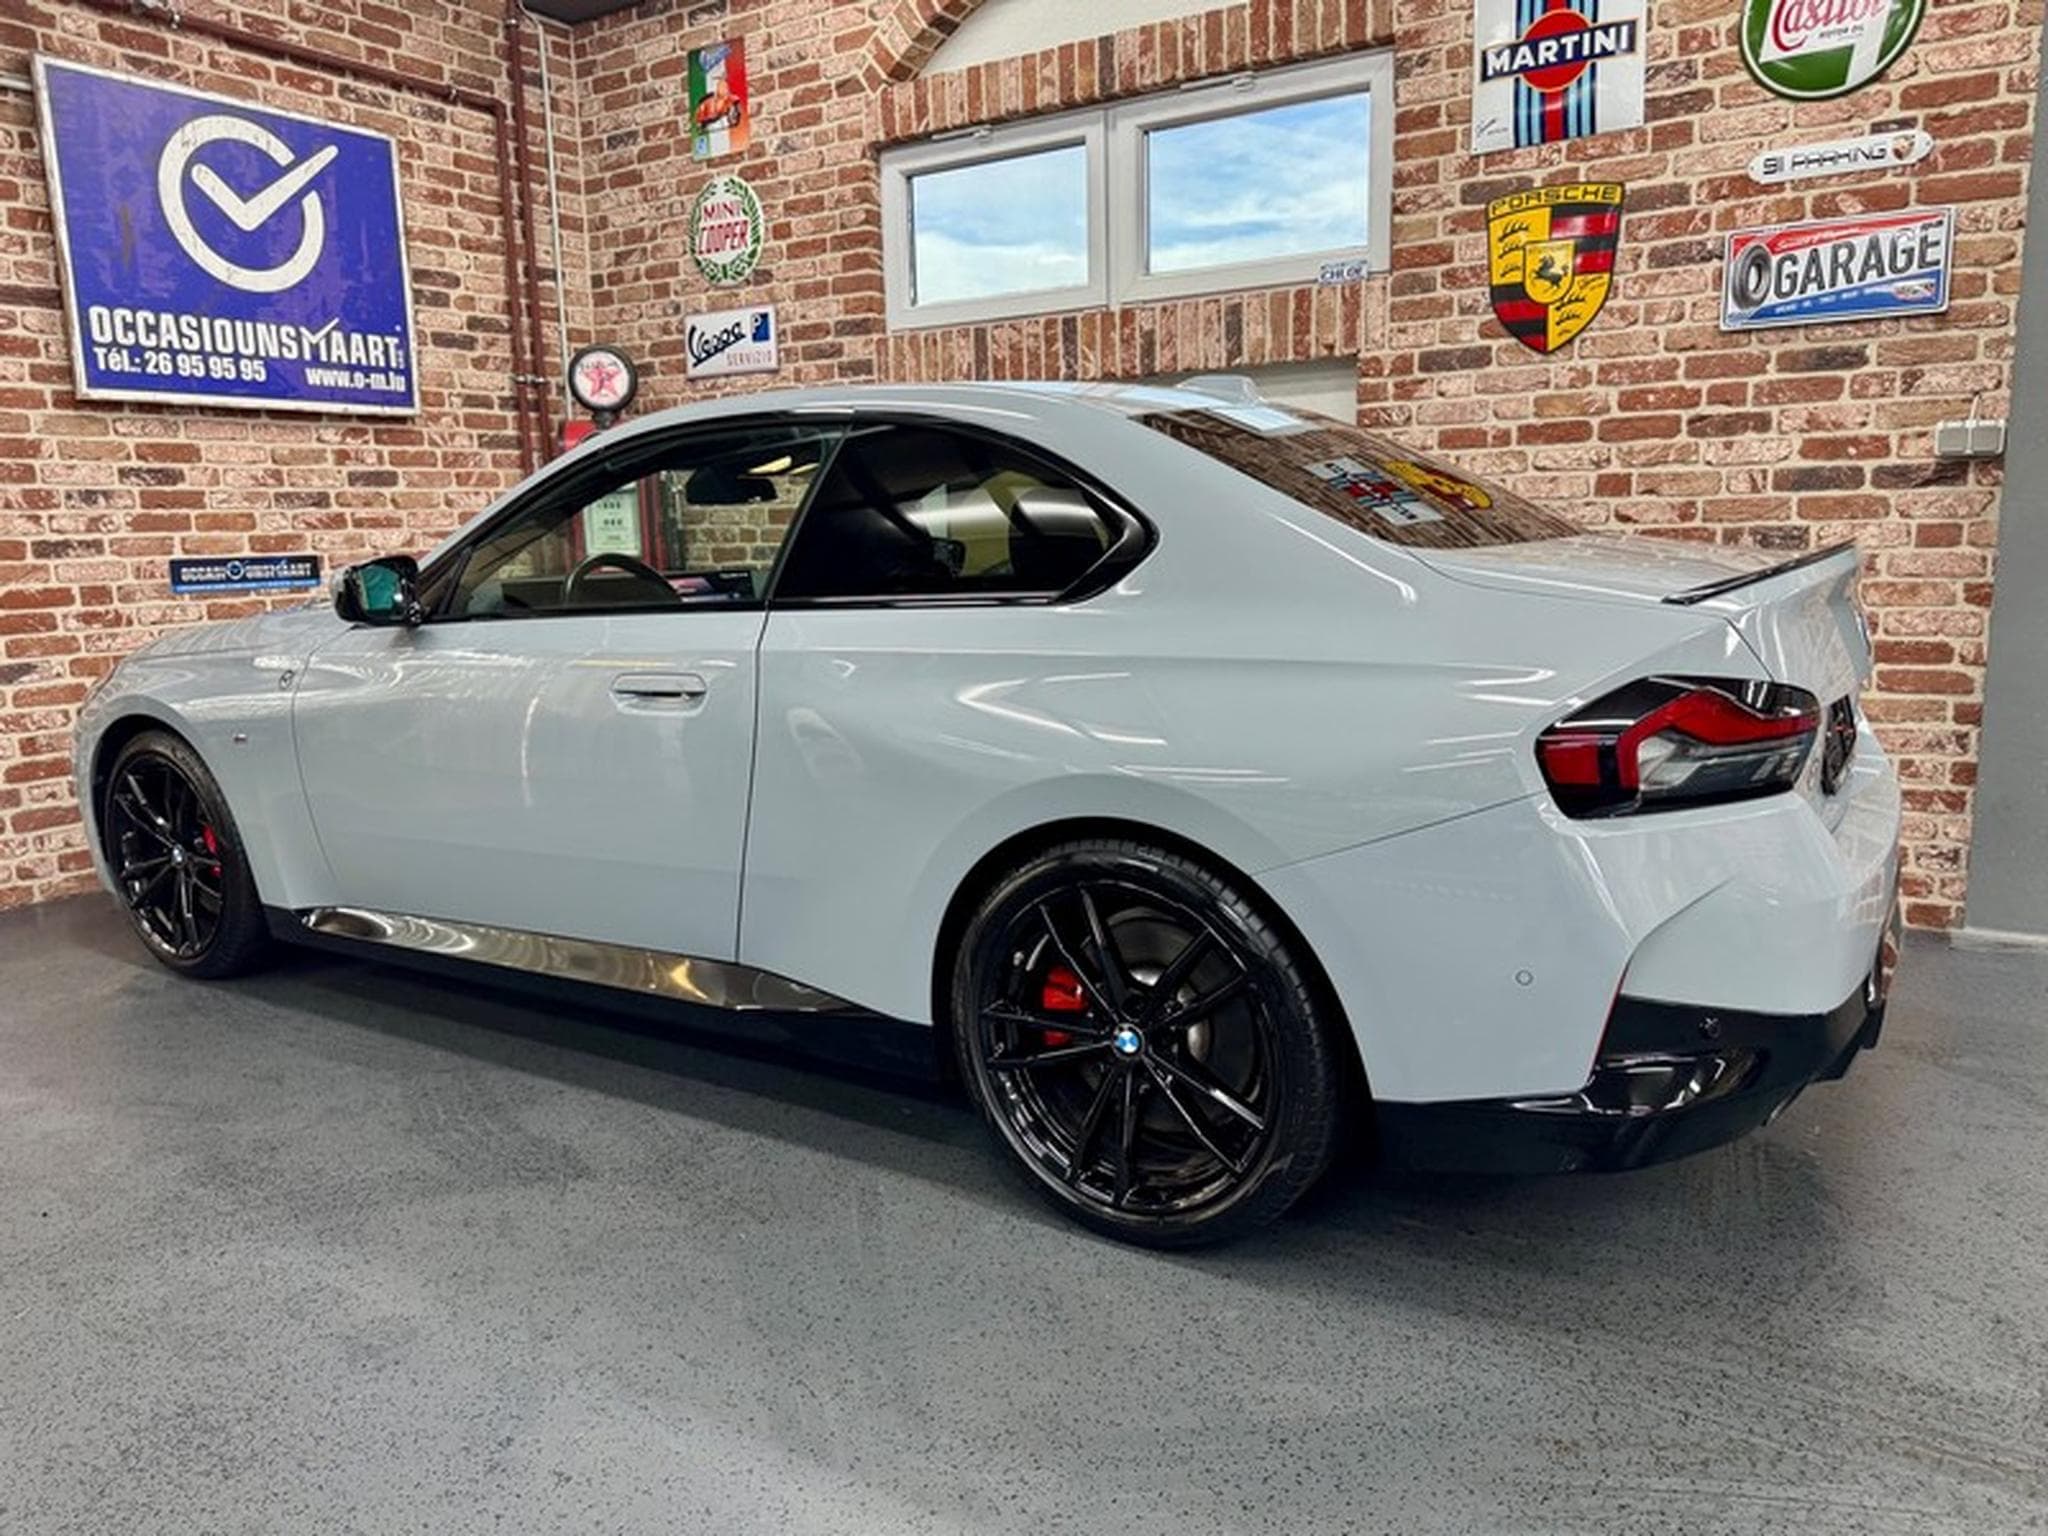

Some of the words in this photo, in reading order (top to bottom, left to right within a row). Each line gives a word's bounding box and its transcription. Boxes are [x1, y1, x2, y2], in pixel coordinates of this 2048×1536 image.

[1772, 0, 1885, 52] Castro
[1486, 25, 1630, 77] MARTINI
[1791, 146, 1889, 171] PARKING
[703, 201, 742, 221] MINI
[1492, 186, 1618, 215] PORSCHE
[698, 220, 748, 255] COOPER
[1774, 229, 1944, 299] GARAGE
[87, 306, 400, 369] OCCASIOUNSMAART
[688, 322, 746, 368] Vespa
[144, 350, 173, 376] 26
[177, 353, 206, 378] 95
[209, 356, 238, 381] 95
[240, 358, 267, 383] 95
[305, 367, 406, 392] www.o-m.lu
